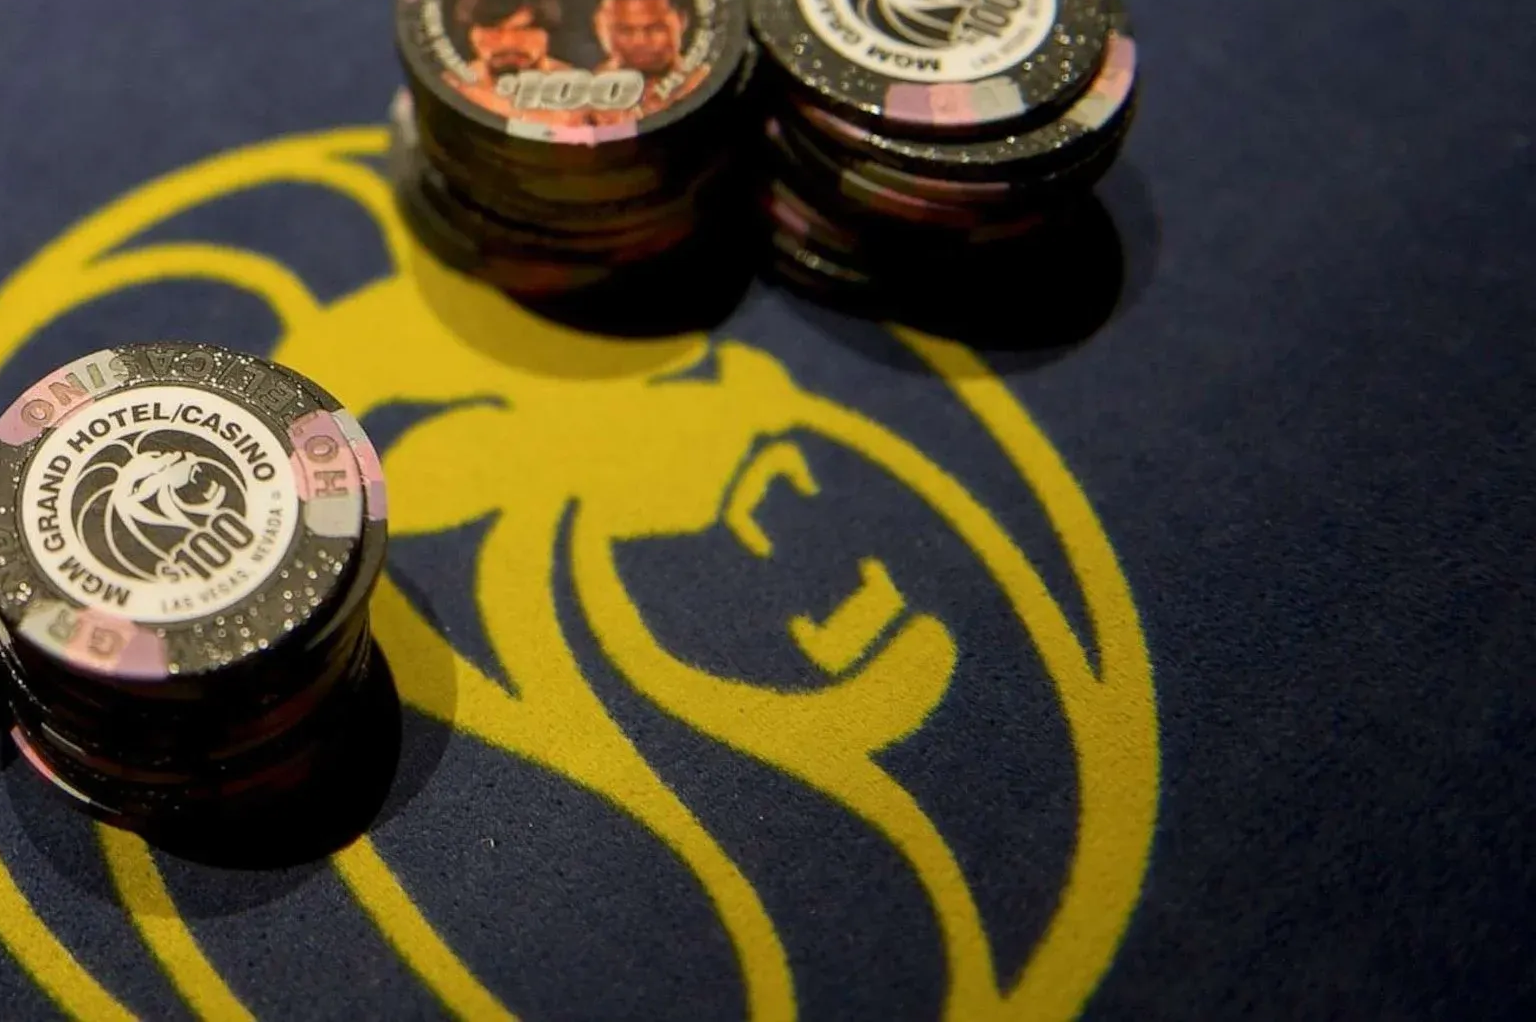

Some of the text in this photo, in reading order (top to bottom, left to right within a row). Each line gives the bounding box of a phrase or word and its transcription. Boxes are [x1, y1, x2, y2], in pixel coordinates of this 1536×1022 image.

[865, 45, 942, 73] MGM
[37, 402, 276, 607] MGM GRAND HOTEL/CASINO
[251, 507, 285, 563] NEVADA
